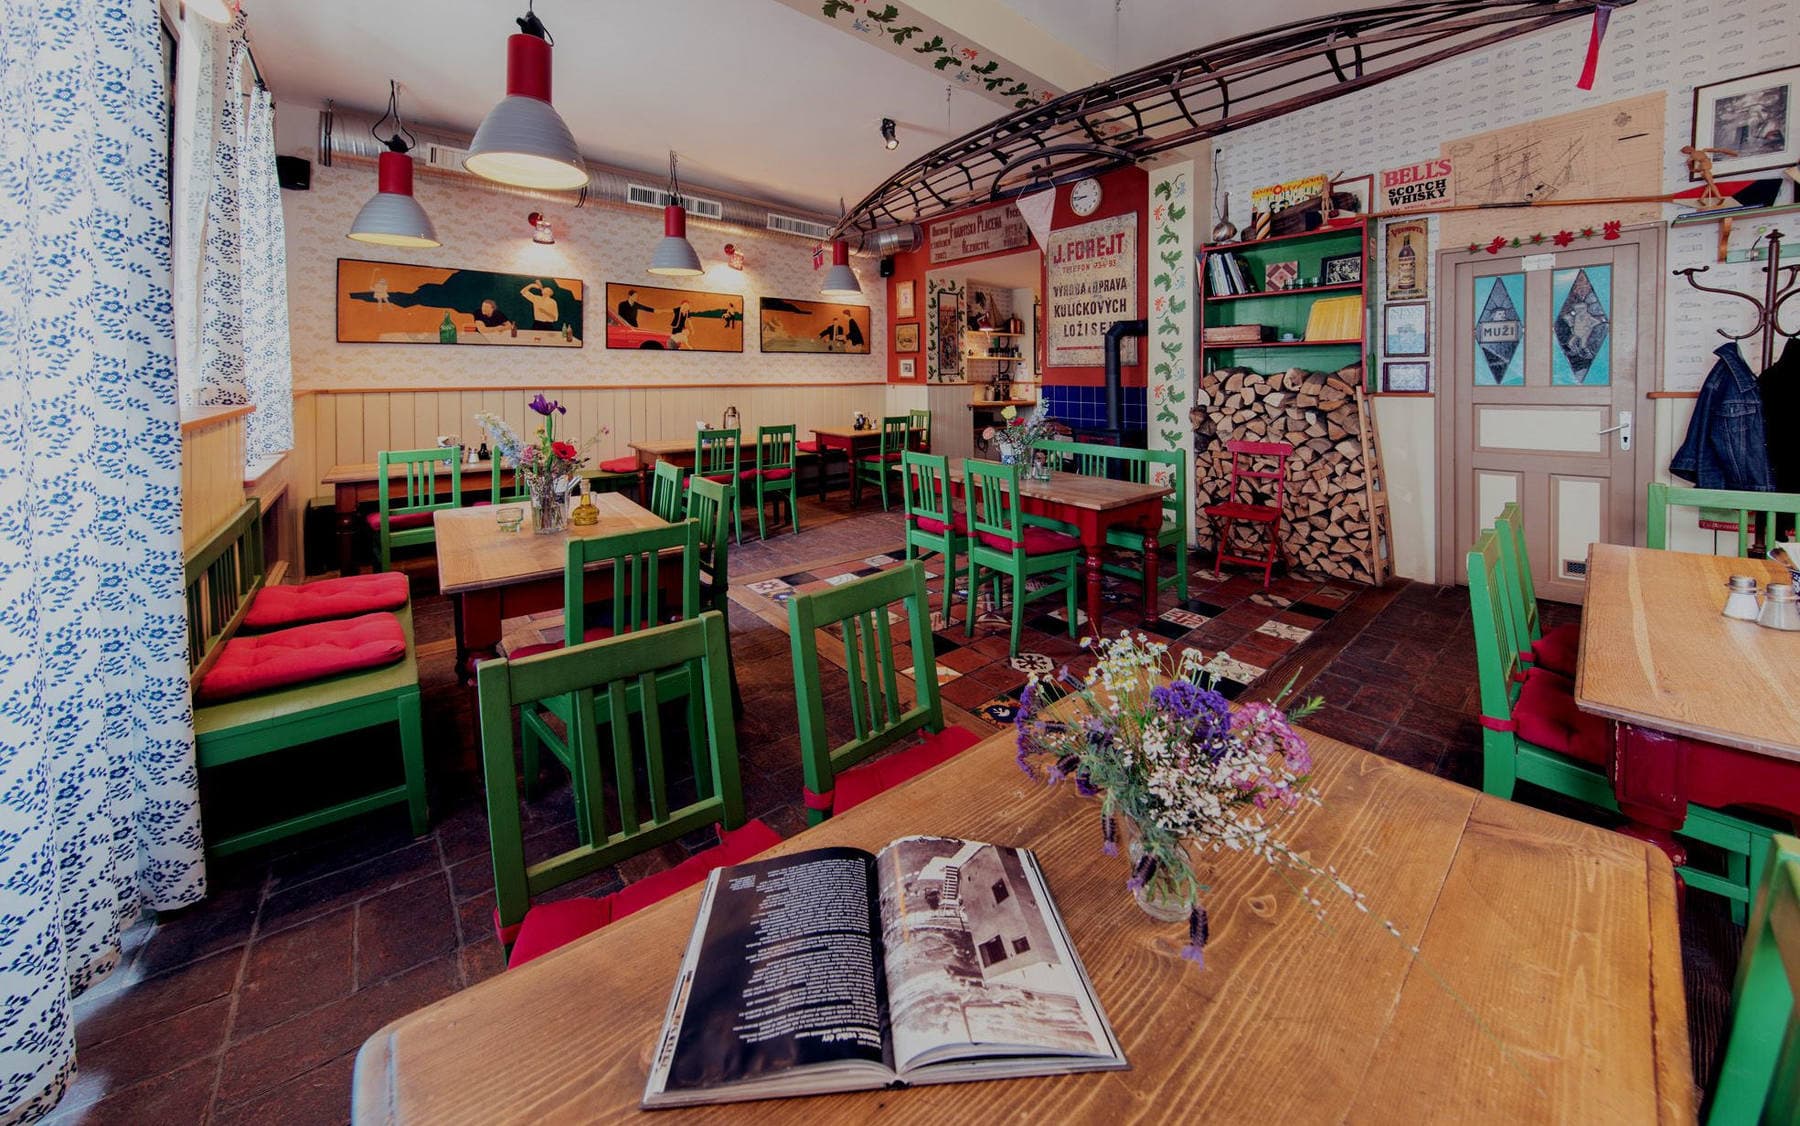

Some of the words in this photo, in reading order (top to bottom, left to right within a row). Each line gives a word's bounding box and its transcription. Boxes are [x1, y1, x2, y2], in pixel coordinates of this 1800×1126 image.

[1384, 159, 1453, 188] BELL'S
[1388, 179, 1447, 198] SCOTCH
[1388, 188, 1447, 206] WHISKY
[1483, 325, 1514, 337] MUŽI
